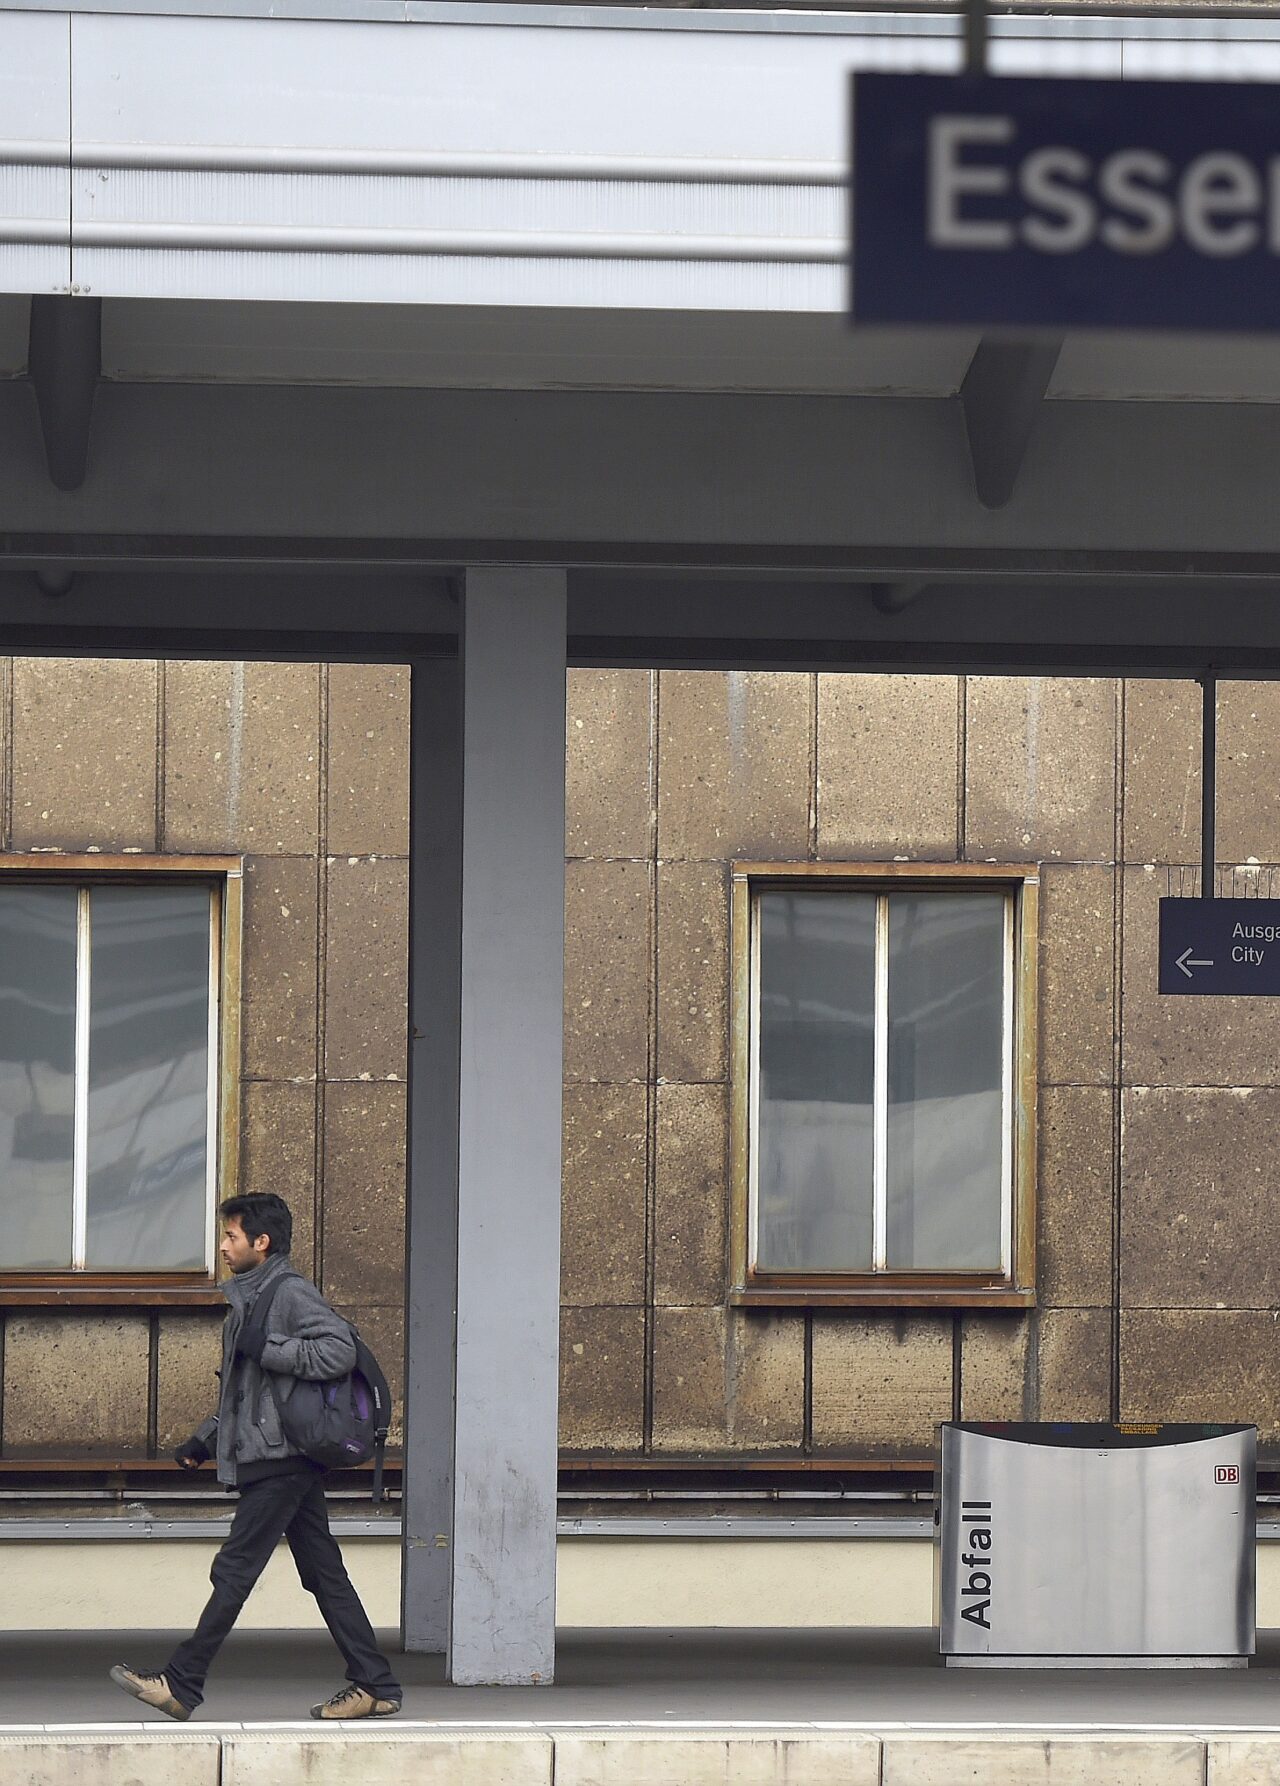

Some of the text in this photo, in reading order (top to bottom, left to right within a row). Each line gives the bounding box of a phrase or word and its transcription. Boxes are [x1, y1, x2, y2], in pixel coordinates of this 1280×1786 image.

[1231, 946, 1264, 965] City
[1217, 1468, 1237, 1482] DB
[961, 1501, 992, 1630] Abfall
